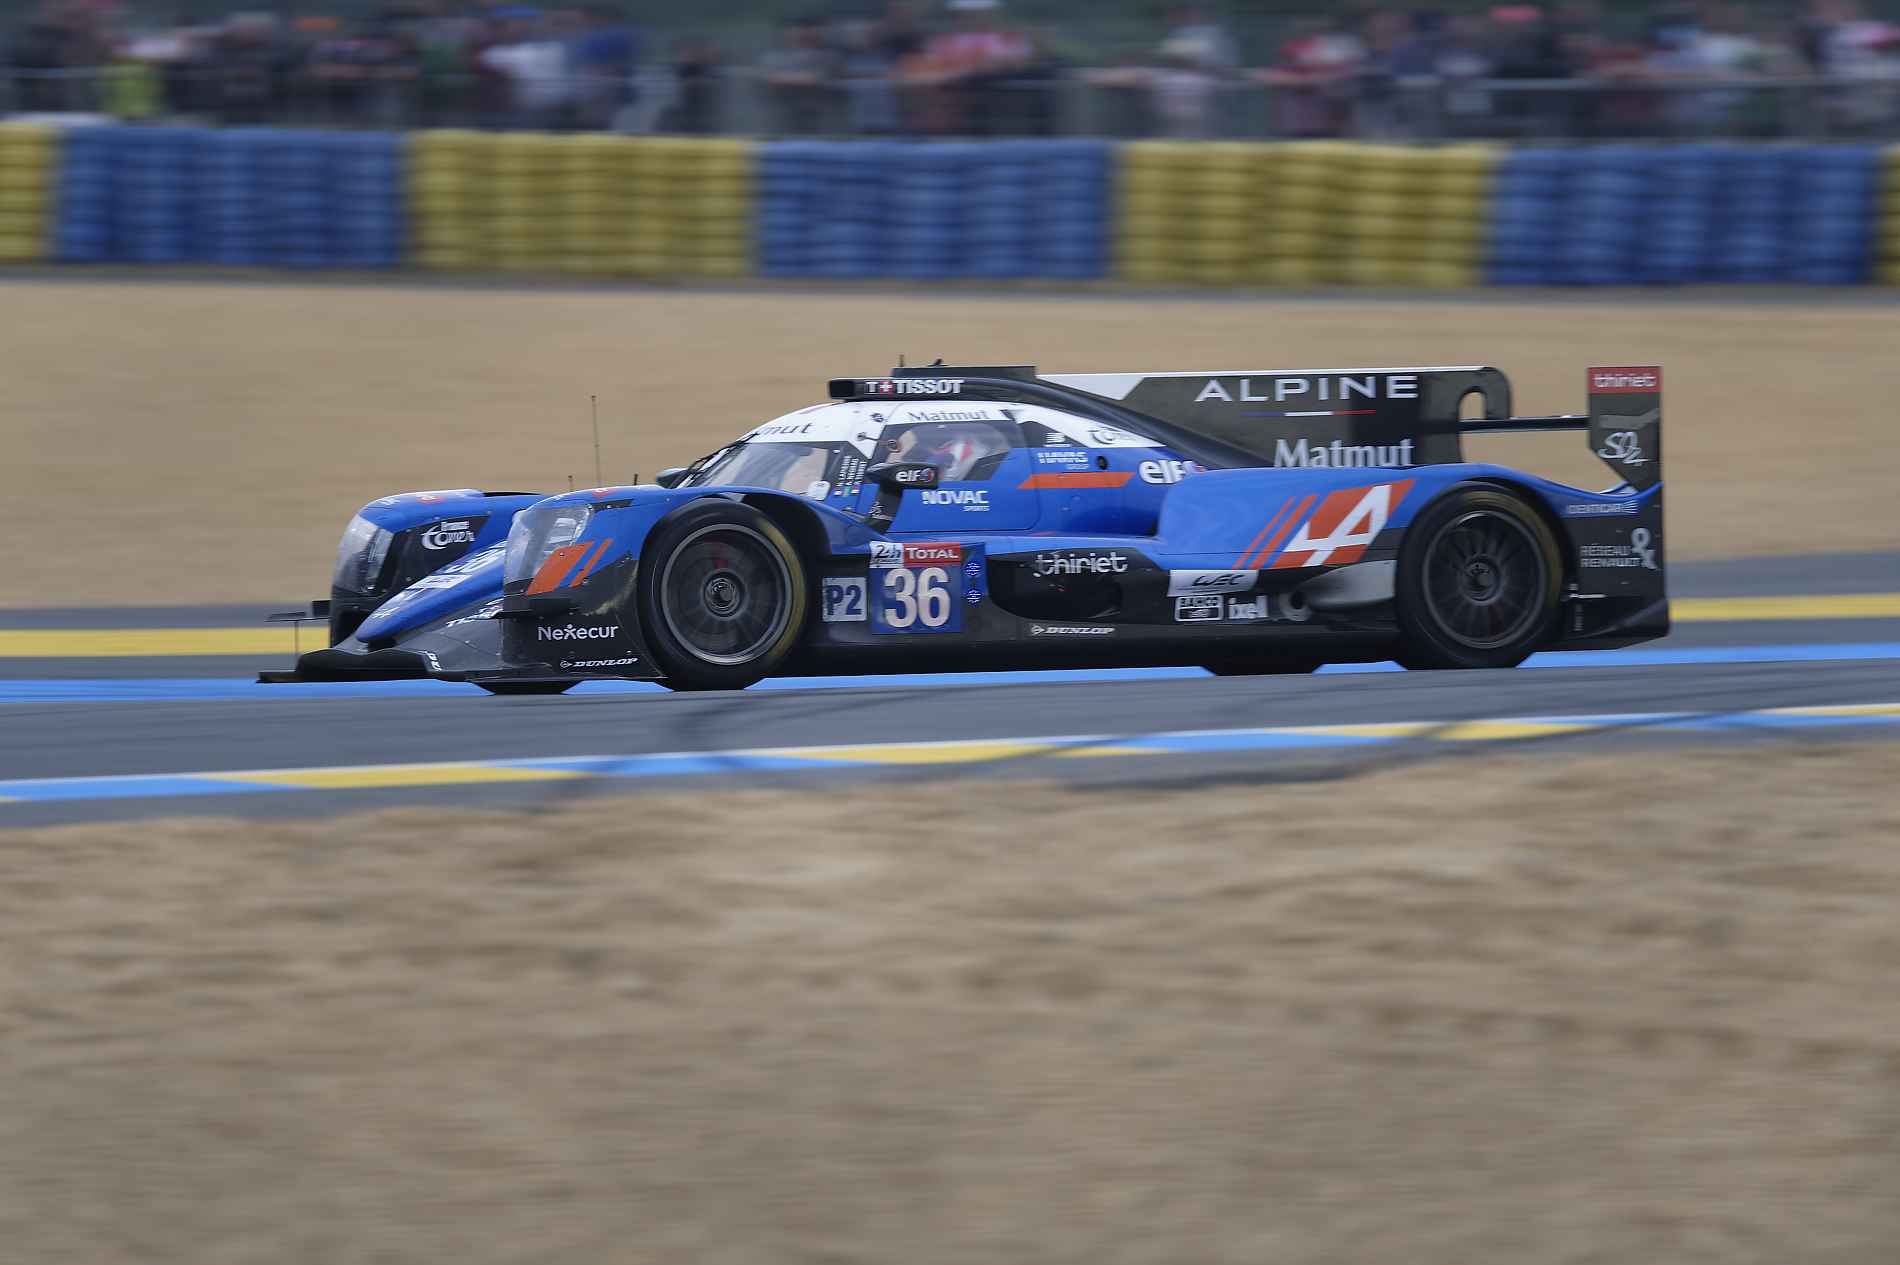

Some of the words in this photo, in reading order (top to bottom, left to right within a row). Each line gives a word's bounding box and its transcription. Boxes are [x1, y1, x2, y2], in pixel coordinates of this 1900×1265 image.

[891, 379, 966, 394] TISSOT
[1194, 375, 1419, 402] ALPINE
[1273, 438, 1415, 468] Matmut
[921, 490, 989, 505] NOVAC
[1033, 551, 1129, 577] thiriet
[1191, 573, 1246, 587] WEC
[825, 584, 863, 616] P2
[884, 567, 950, 628] 36
[537, 623, 619, 641] Nexecur
[1043, 626, 1116, 635] DUNLOP
[572, 657, 639, 668] DUNLOP
